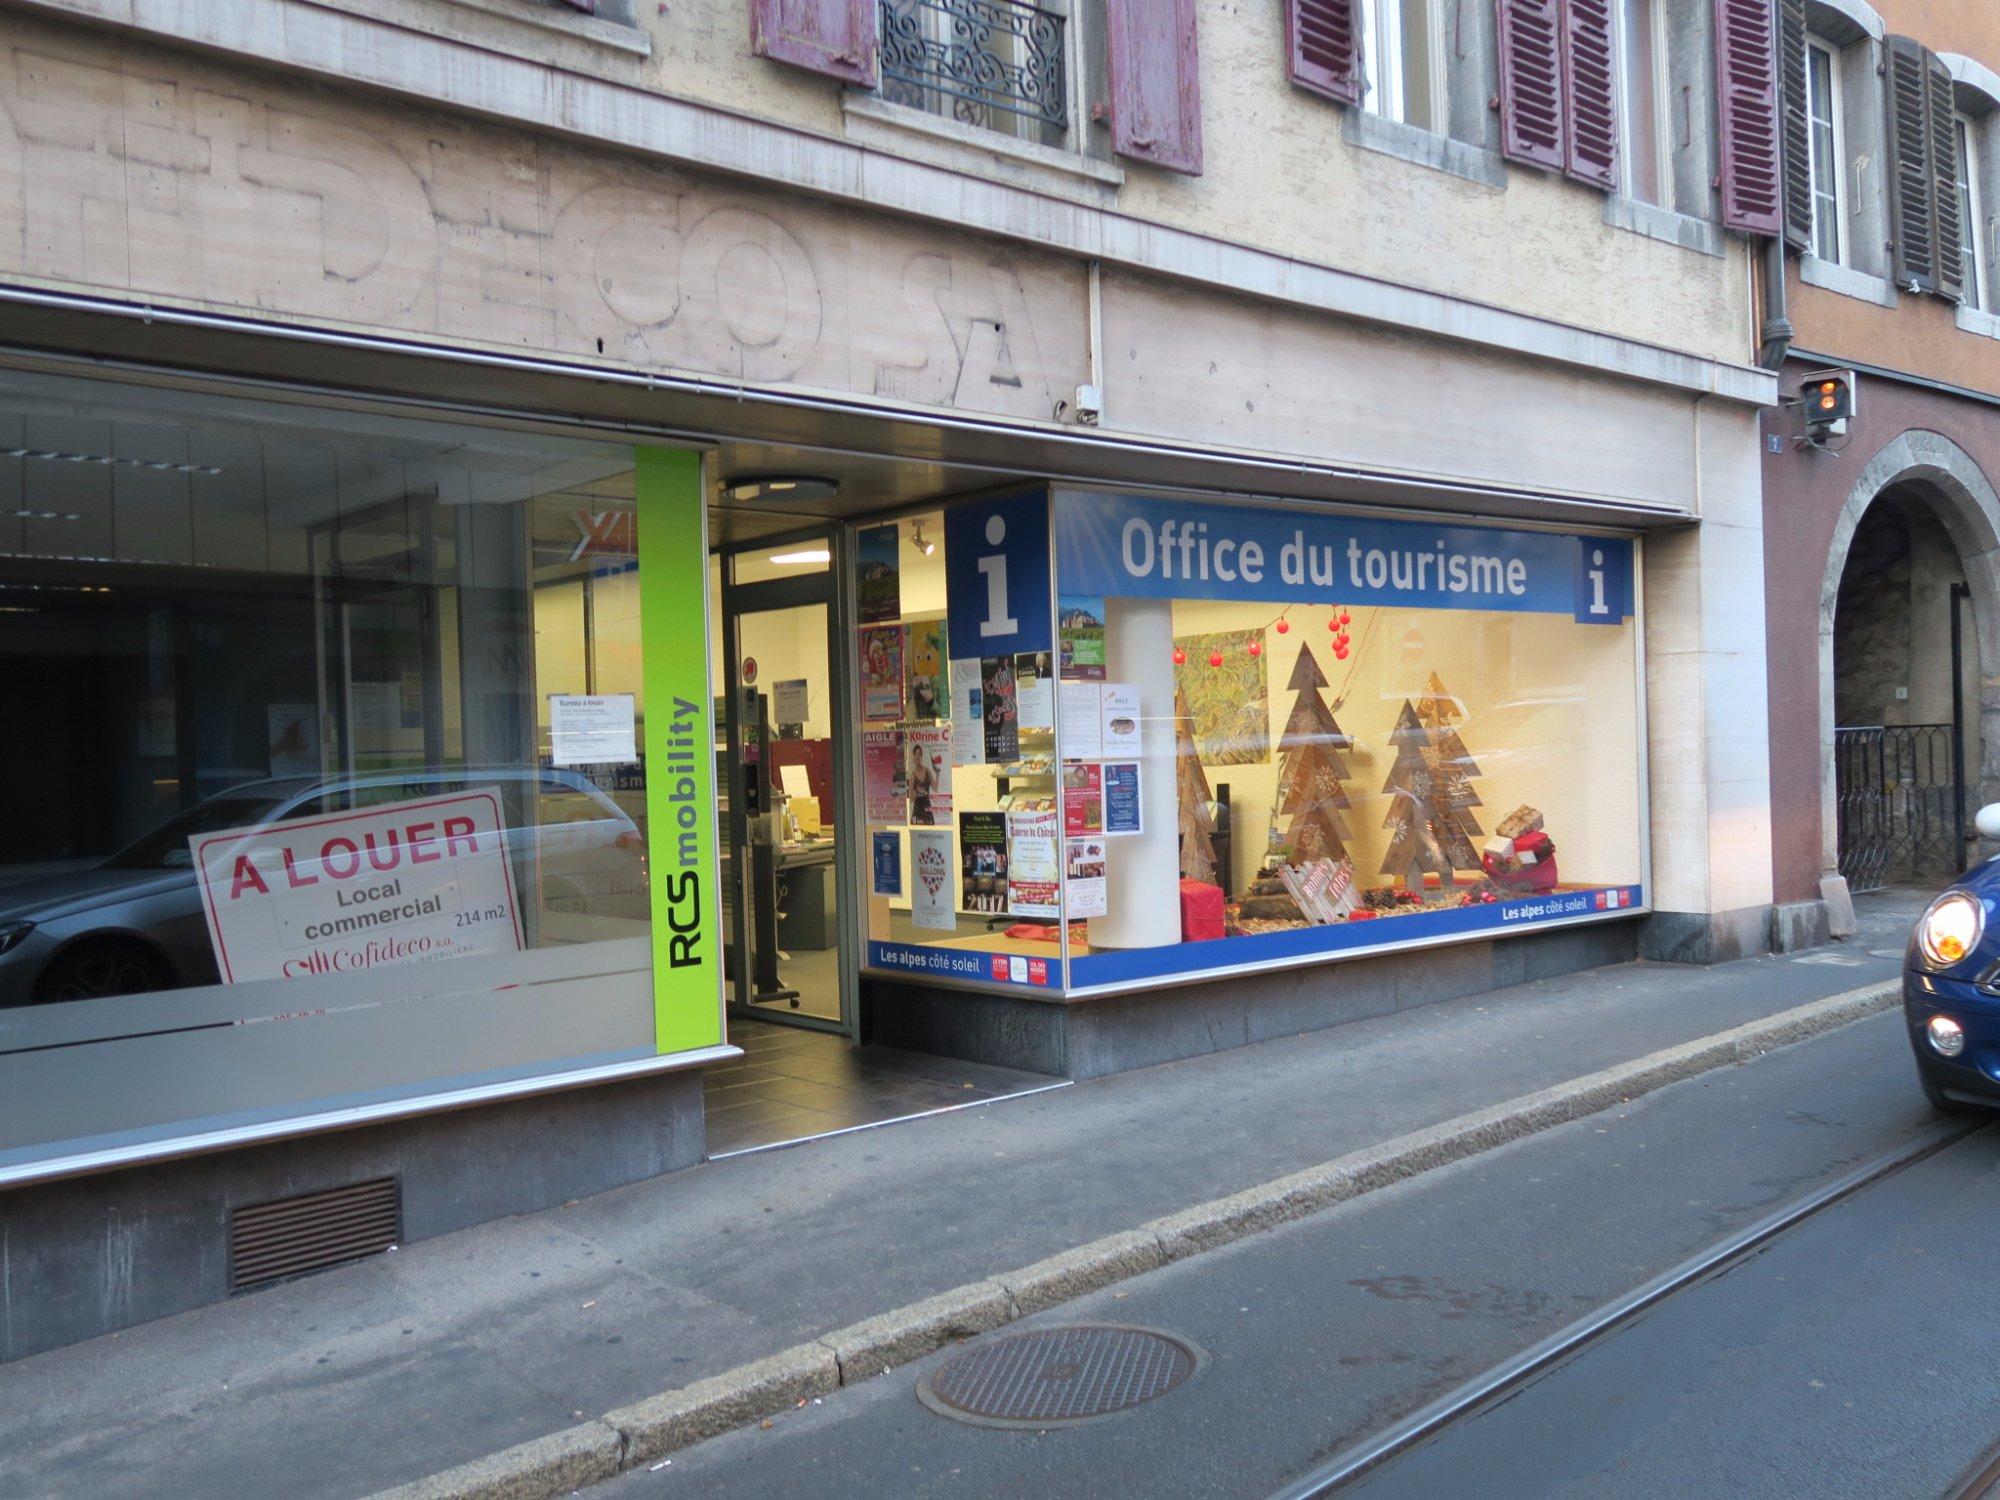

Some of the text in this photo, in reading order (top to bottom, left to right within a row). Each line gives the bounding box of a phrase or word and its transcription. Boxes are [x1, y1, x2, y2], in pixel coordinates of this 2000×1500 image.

[1121, 517, 1527, 597] Office du tourisme
[865, 732, 896, 742] AIGLE
[909, 729, 949, 742] Karine C
[230, 815, 479, 899] A LOUER
[337, 878, 402, 908] Local
[305, 895, 442, 940] commercial
[456, 904, 506, 928] 214 m2
[1502, 907, 1519, 921] Les
[1520, 904, 1545, 920] alpes
[1545, 900, 1564, 915] côté
[1565, 896, 1587, 912] soleil
[333, 936, 431, 972] Cofideco
[880, 948, 980, 973] Les alpes côté soleil
